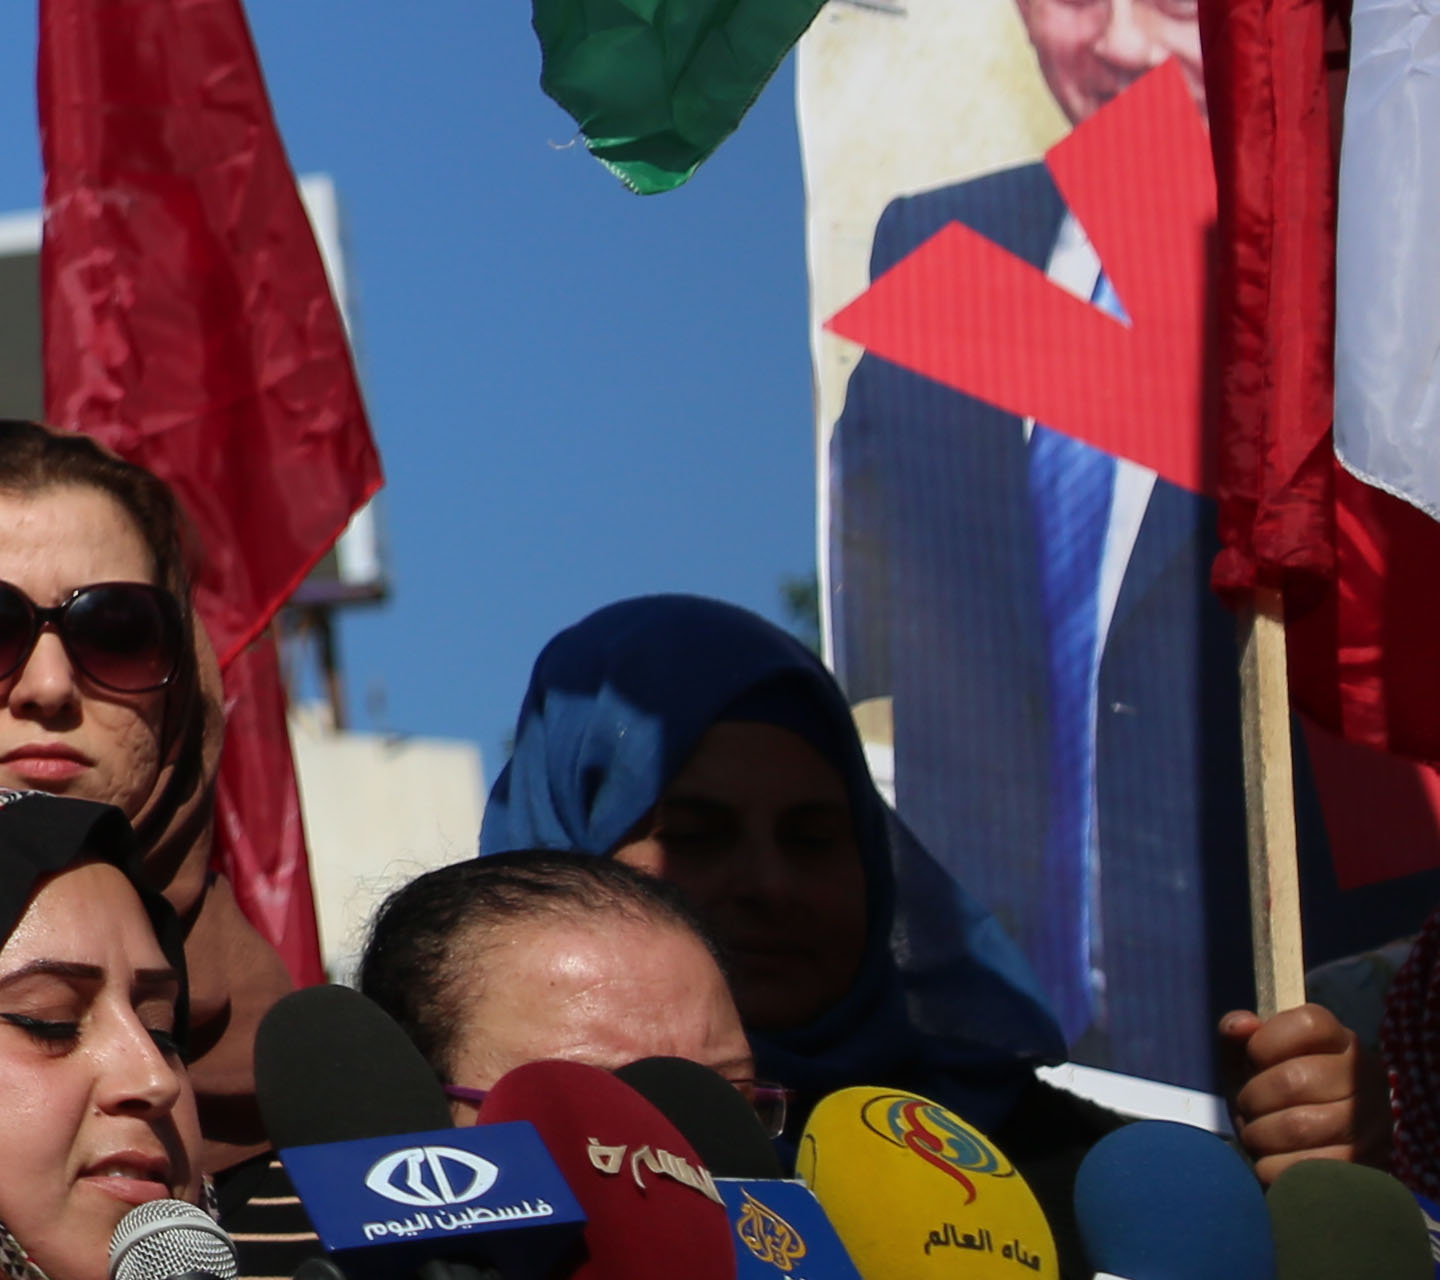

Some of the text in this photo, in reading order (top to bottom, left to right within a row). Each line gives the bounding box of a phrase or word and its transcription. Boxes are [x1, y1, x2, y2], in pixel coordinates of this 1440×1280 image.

[363, 1198, 553, 1240] فلسطين اليوم
[924, 1222, 993, 1255] العالم
